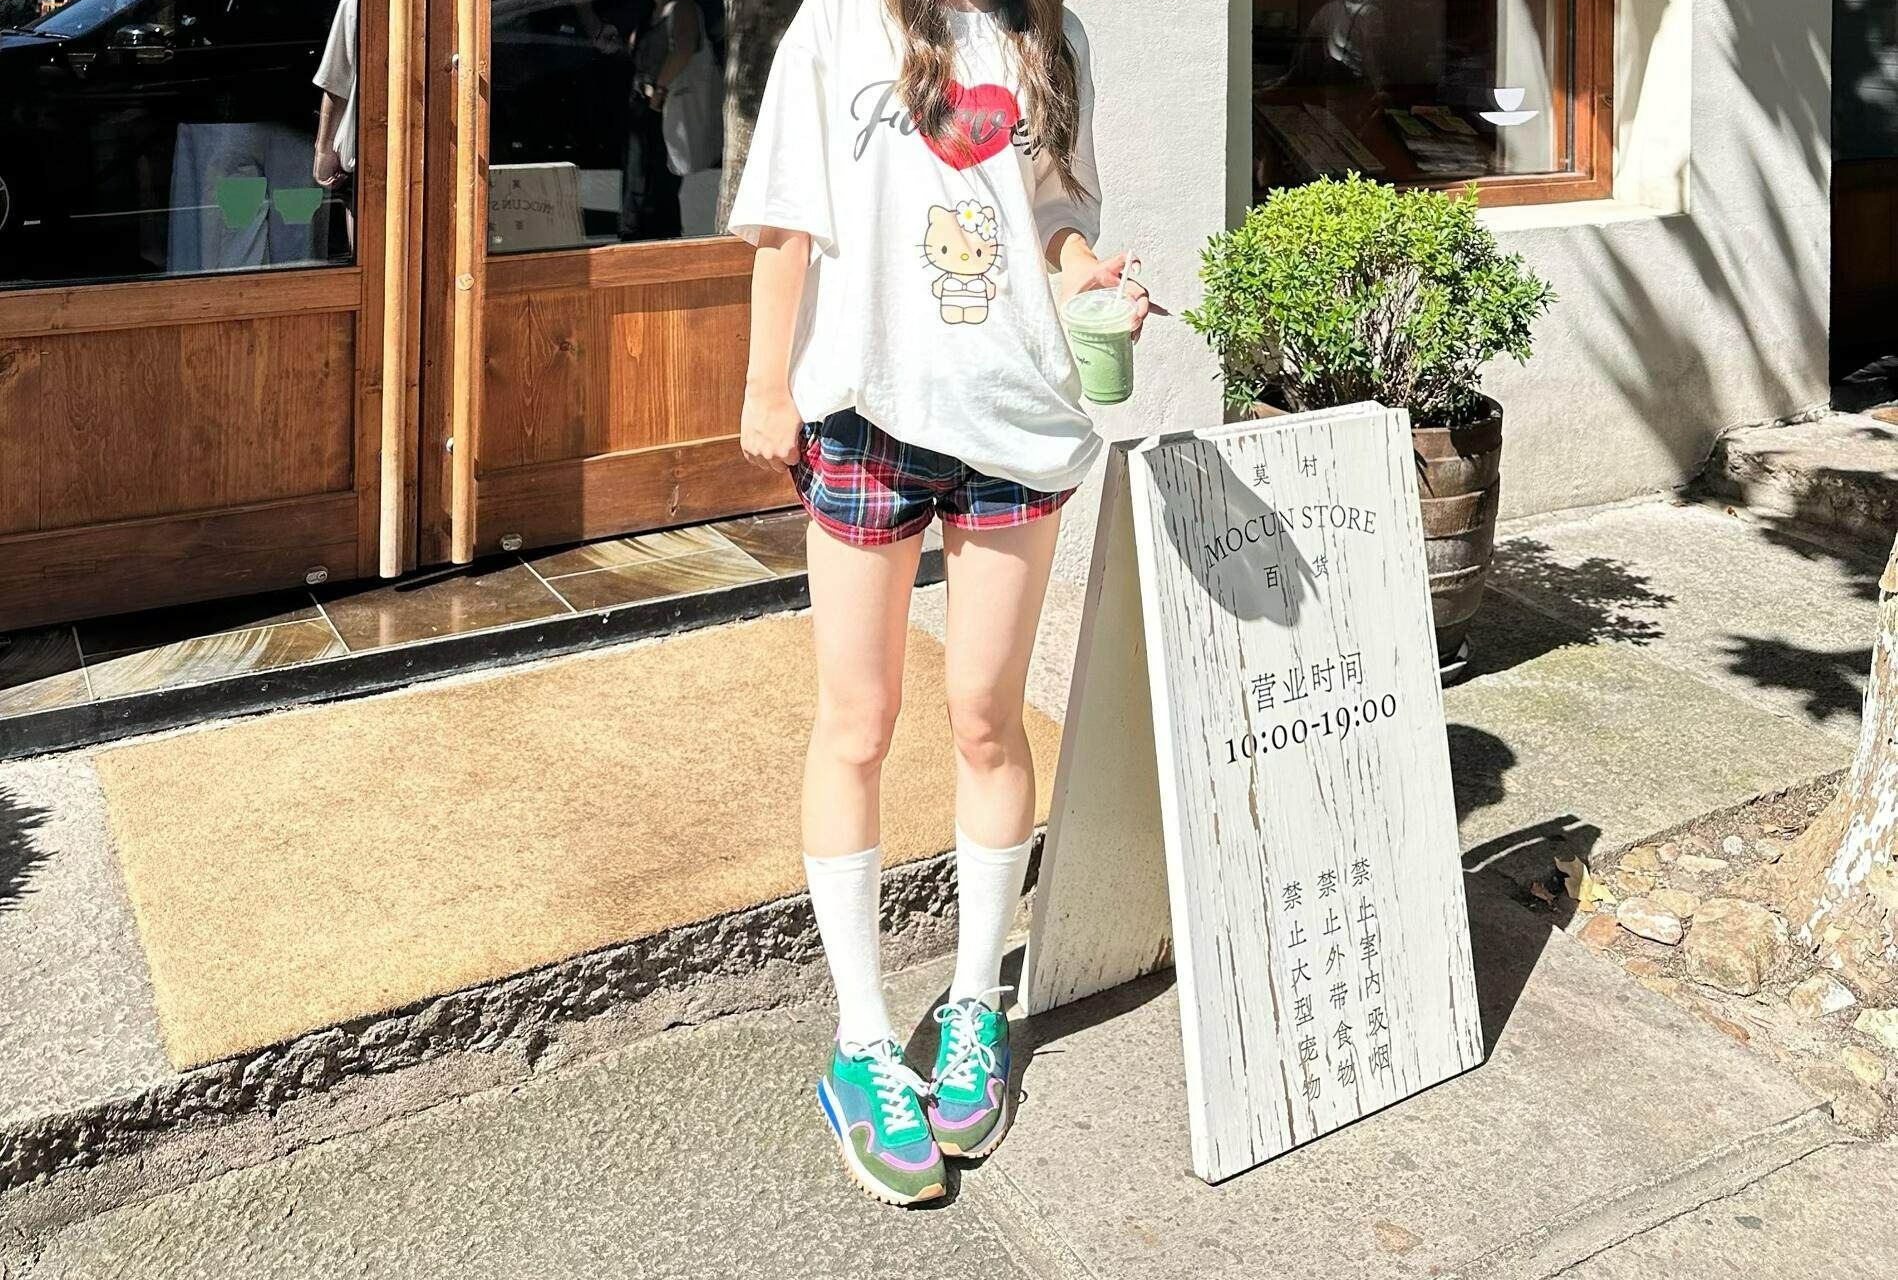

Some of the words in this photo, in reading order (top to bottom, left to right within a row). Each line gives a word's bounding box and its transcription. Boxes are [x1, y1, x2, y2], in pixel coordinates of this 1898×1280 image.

[1204, 508, 1294, 568] MOCUN
[1302, 505, 1377, 534] STORE
[1225, 693, 1397, 764] 10:00-19:00
[1251, 651, 1364, 713] 营业时间
[1282, 880, 1322, 1100] 禁止大型宠物
[1316, 868, 1356, 1088] 禁止外带食物
[1350, 856, 1391, 1072] 禁止室内吸烟
